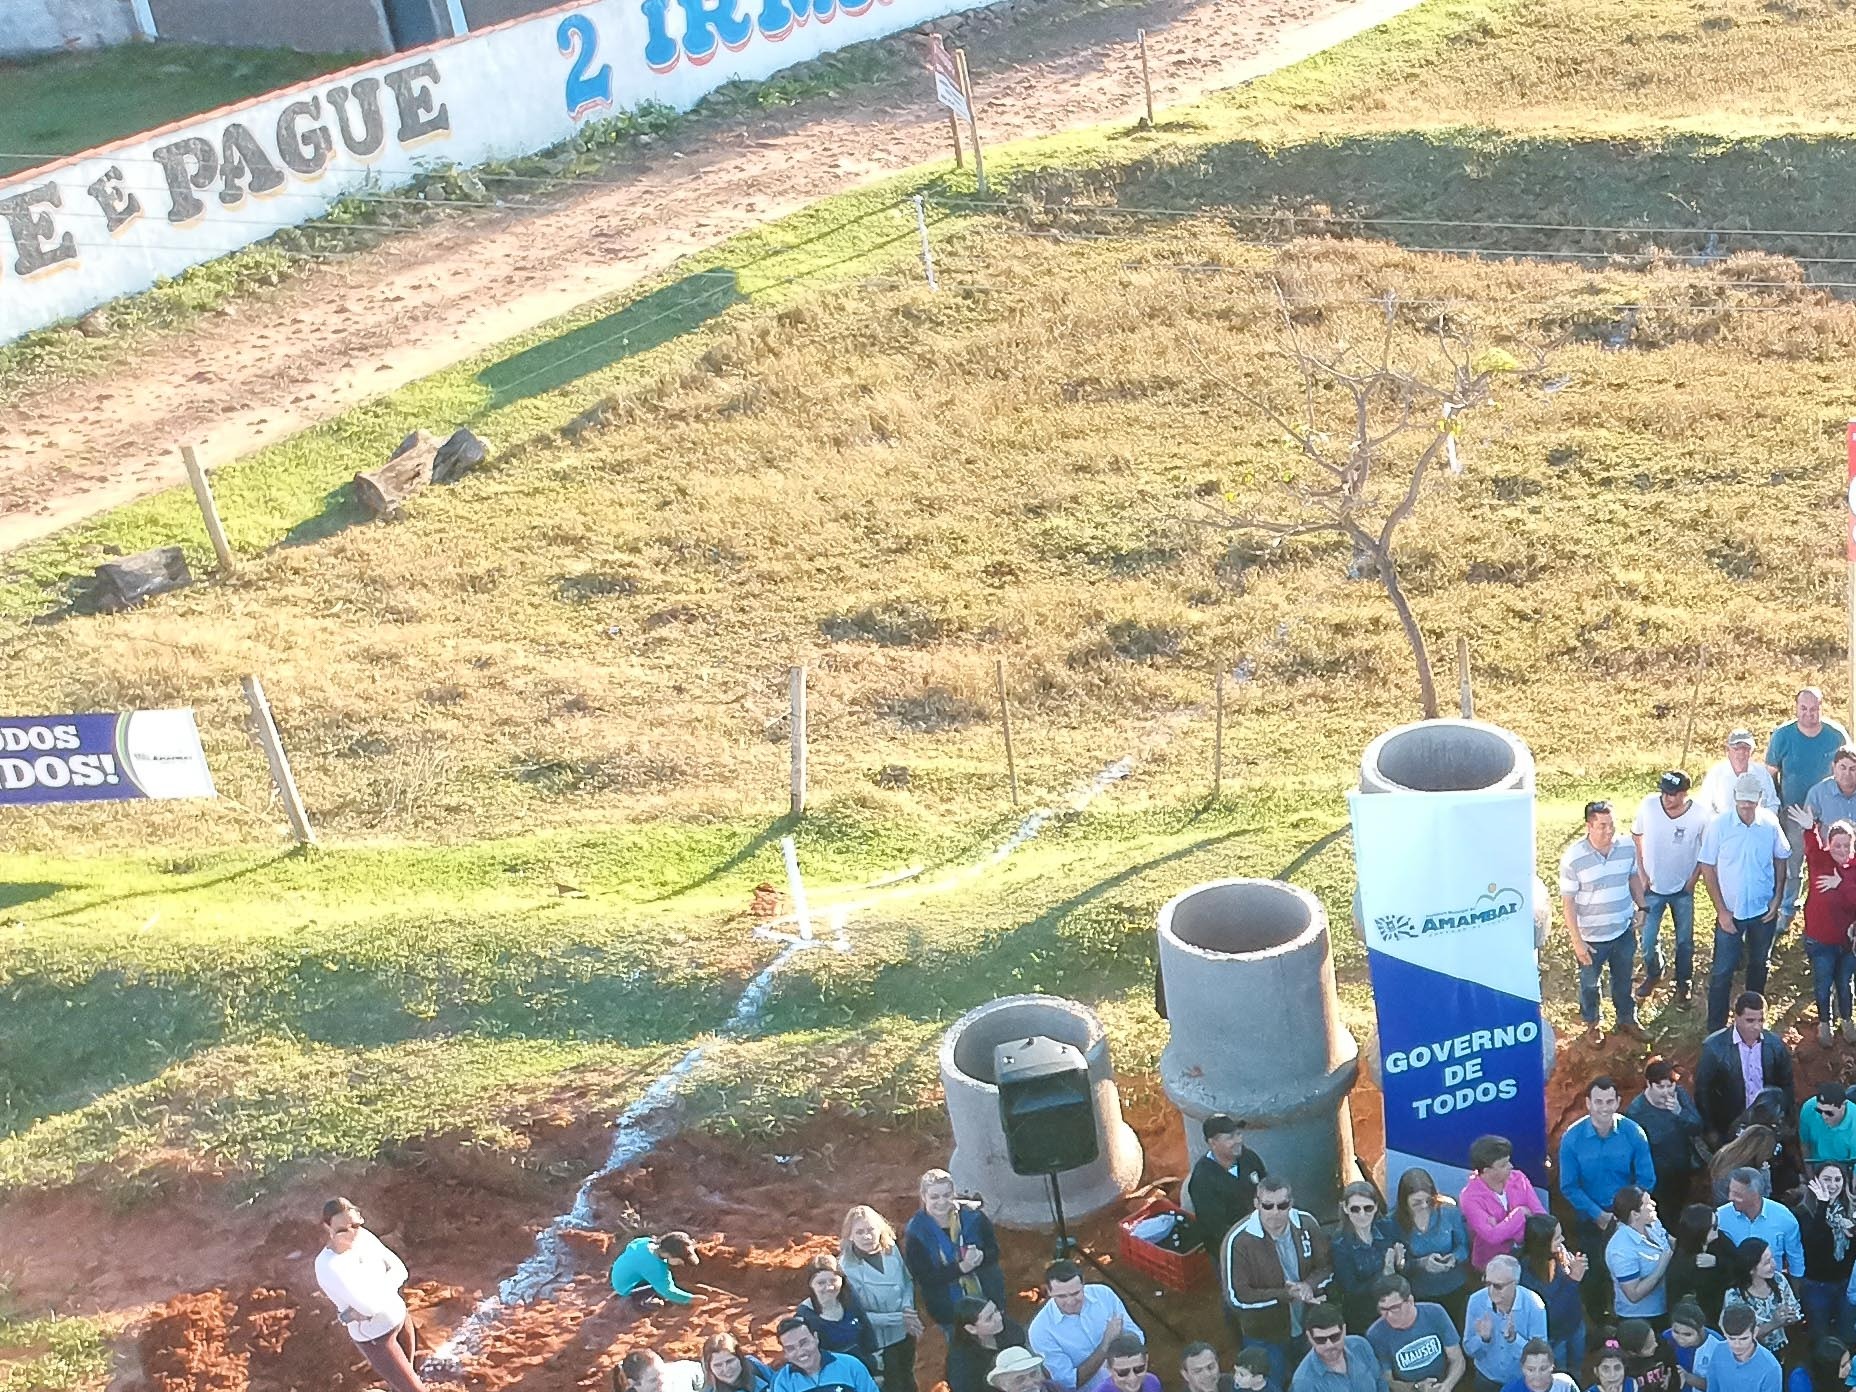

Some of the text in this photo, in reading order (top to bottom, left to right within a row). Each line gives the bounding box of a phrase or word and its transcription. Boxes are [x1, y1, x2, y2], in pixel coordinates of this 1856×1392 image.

[556, 16, 612, 116] 2
[153, 59, 450, 223] PAGUE
[0, 725, 80, 751] DOS
[0, 754, 119, 789] DOS!
[1421, 902, 1517, 934] AMAMBAI
[1386, 1021, 1538, 1074] GOVERNO
[1445, 1058, 1483, 1087] DE
[1412, 1079, 1518, 1119] TODOS
